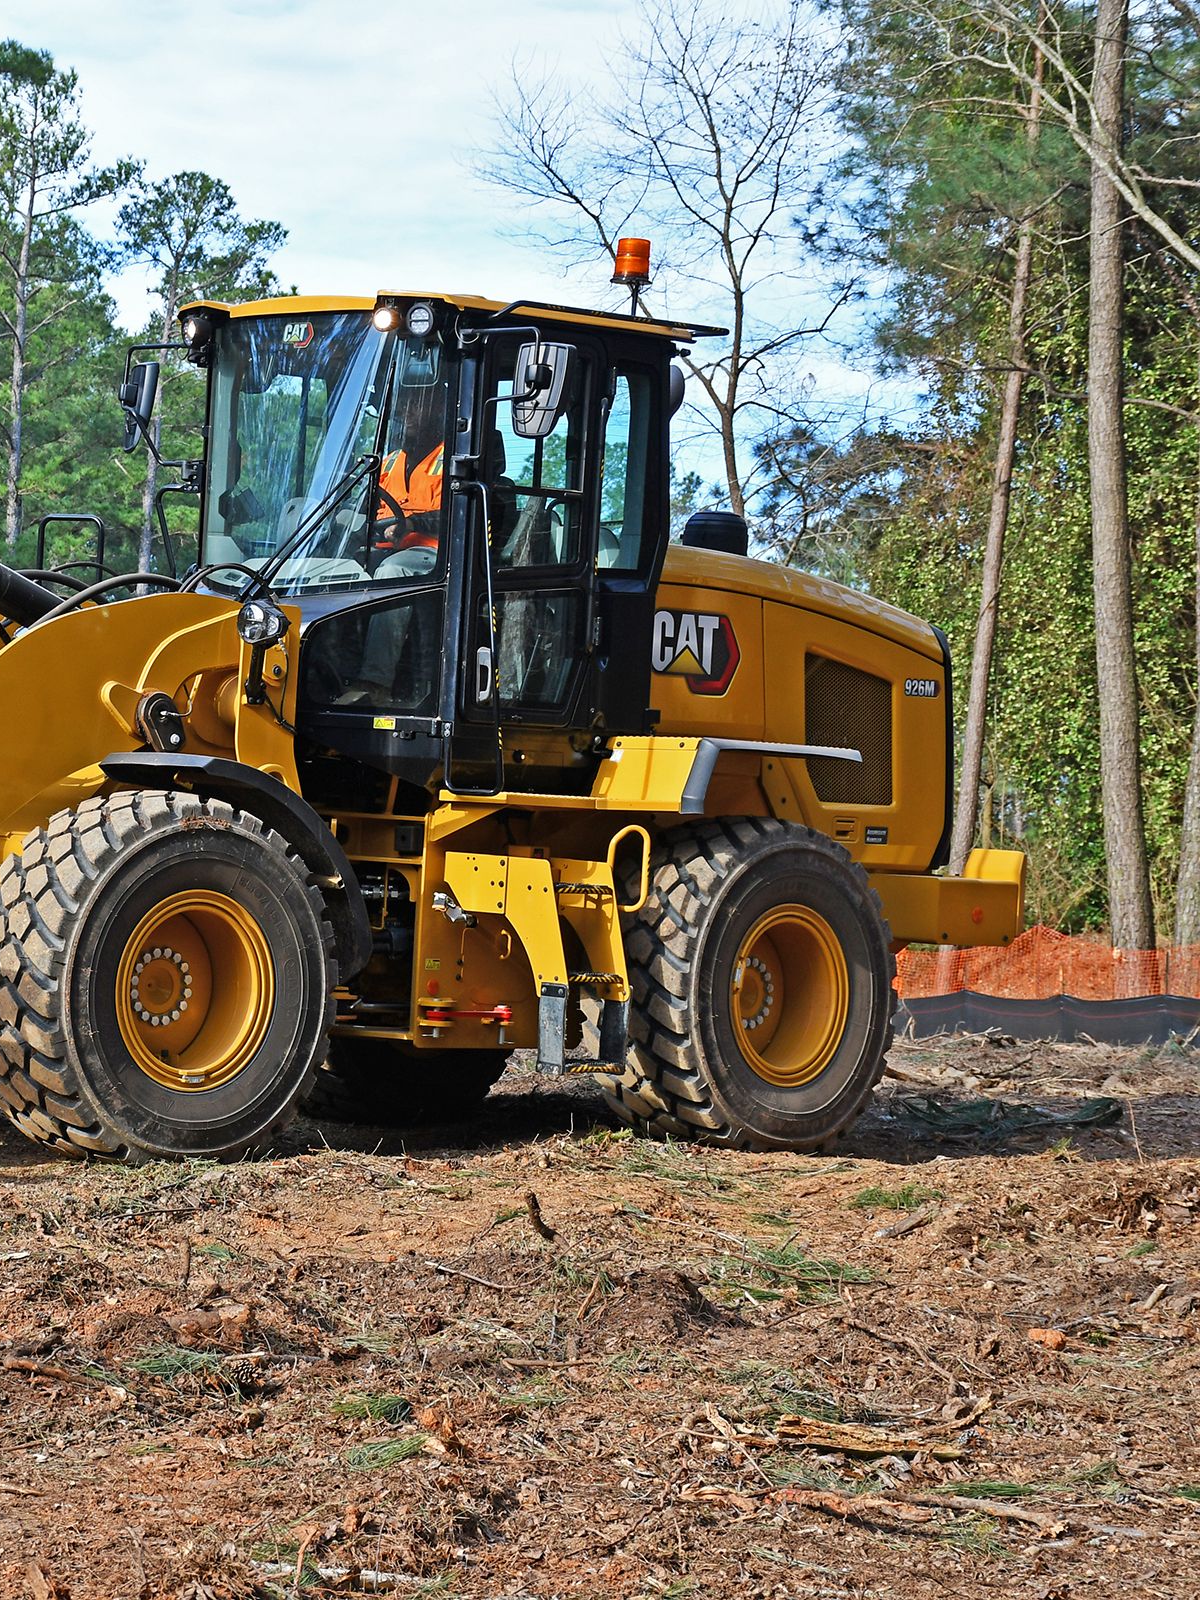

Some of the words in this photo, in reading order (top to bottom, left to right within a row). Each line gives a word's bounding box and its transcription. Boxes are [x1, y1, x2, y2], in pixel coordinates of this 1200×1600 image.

[283, 323, 308, 342] CAT
[652, 610, 719, 675] CAT
[905, 679, 935, 696] 926M
